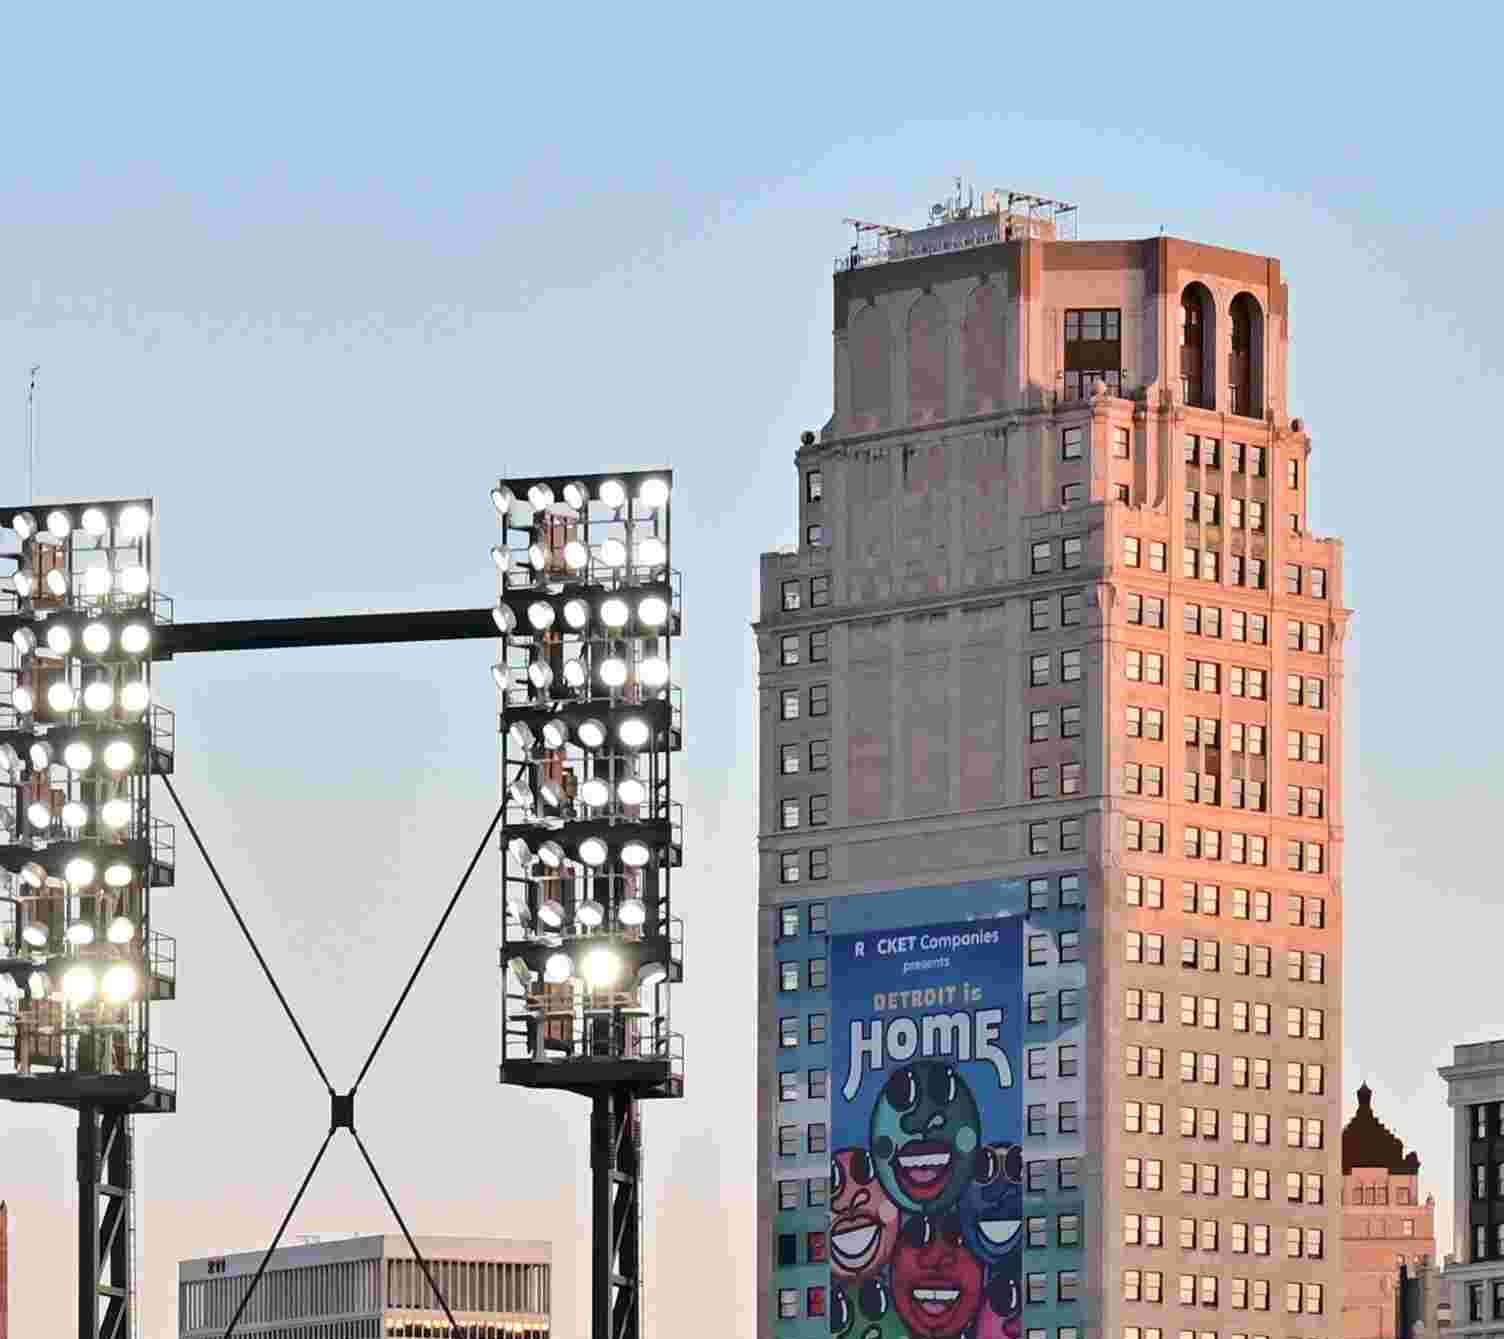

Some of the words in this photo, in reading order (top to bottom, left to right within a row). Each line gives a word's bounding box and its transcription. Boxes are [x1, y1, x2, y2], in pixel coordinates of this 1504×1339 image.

[920, 929, 999, 952] Companies
[903, 957, 950, 975] presents
[873, 986, 957, 1011] DETROIT
